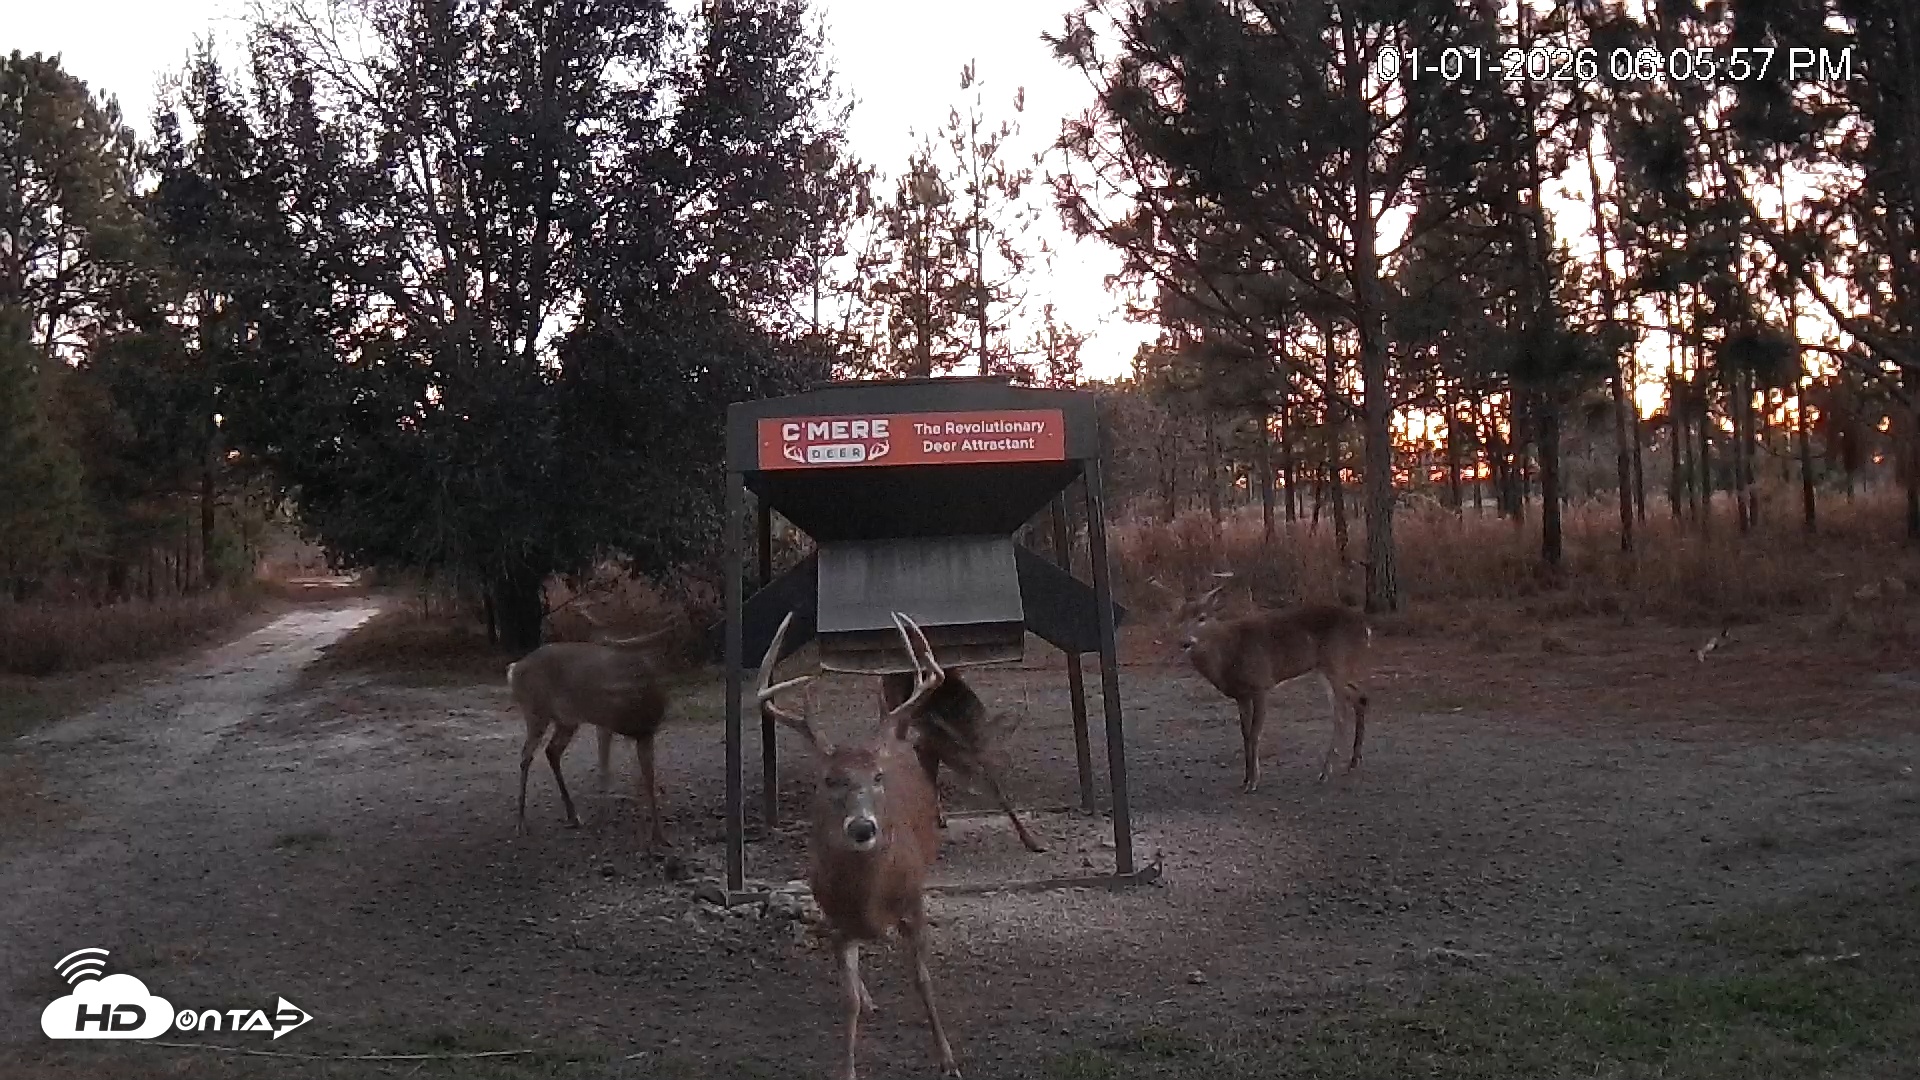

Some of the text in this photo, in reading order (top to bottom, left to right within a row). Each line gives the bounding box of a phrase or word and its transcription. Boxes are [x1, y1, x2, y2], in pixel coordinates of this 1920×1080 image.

[782, 420, 889, 441] C'MERE
[914, 420, 1045, 435] The Revolutionary
[923, 437, 1035, 453] Deer Attractant
[811, 447, 861, 459] DEER
